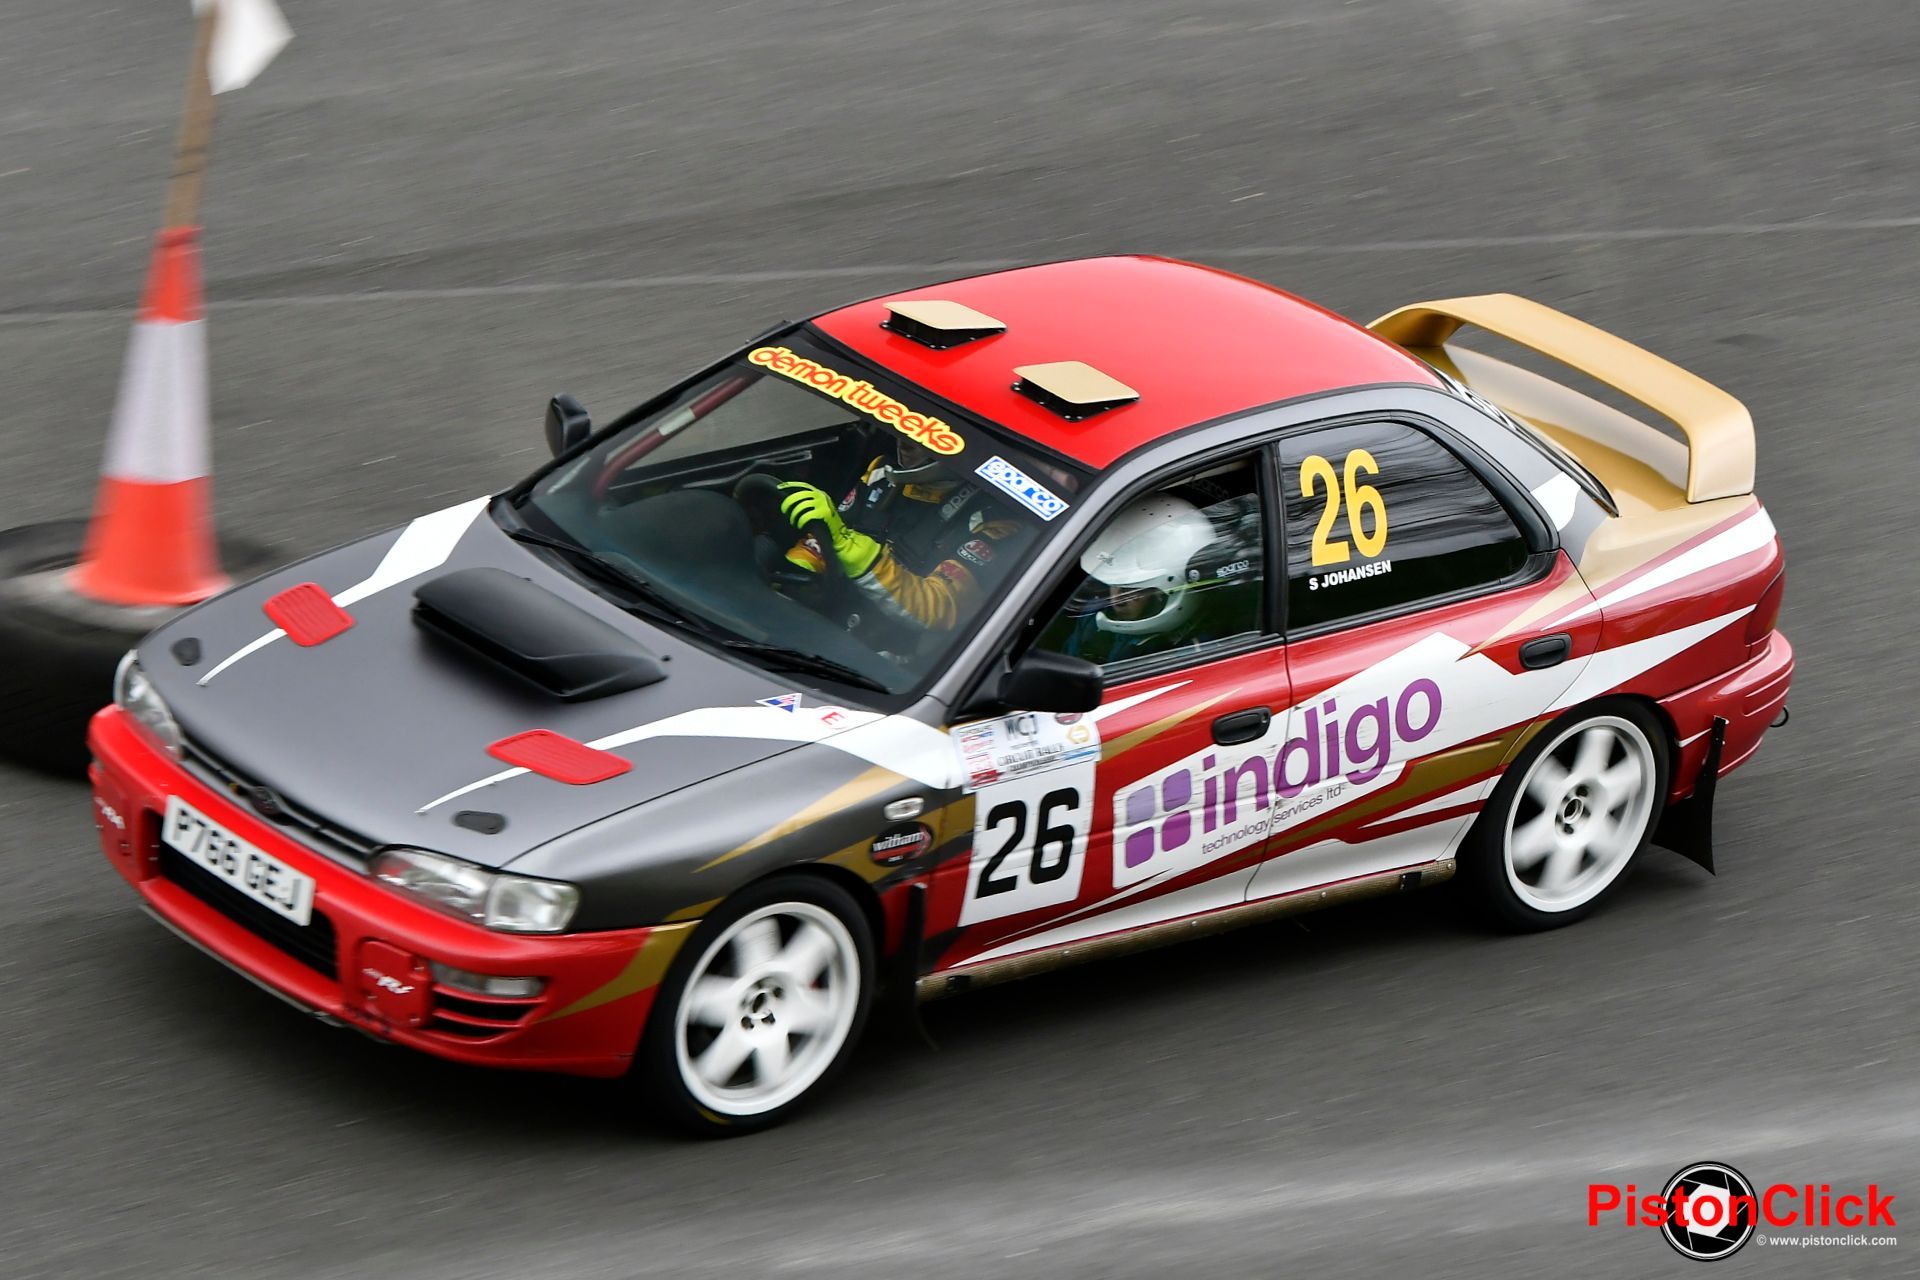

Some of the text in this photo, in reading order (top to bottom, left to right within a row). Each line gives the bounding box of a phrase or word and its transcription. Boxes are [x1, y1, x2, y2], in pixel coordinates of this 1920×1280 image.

[987, 460, 1066, 514] sparco
[1300, 449, 1388, 567] 26
[1309, 560, 1392, 591] S JOHANSEN
[1203, 678, 1443, 834] indigo
[173, 808, 242, 876] P766
[245, 854, 301, 910] GEJ
[974, 787, 1080, 899] 26
[1202, 818, 1271, 854] technology
[1274, 794, 1323, 824] services
